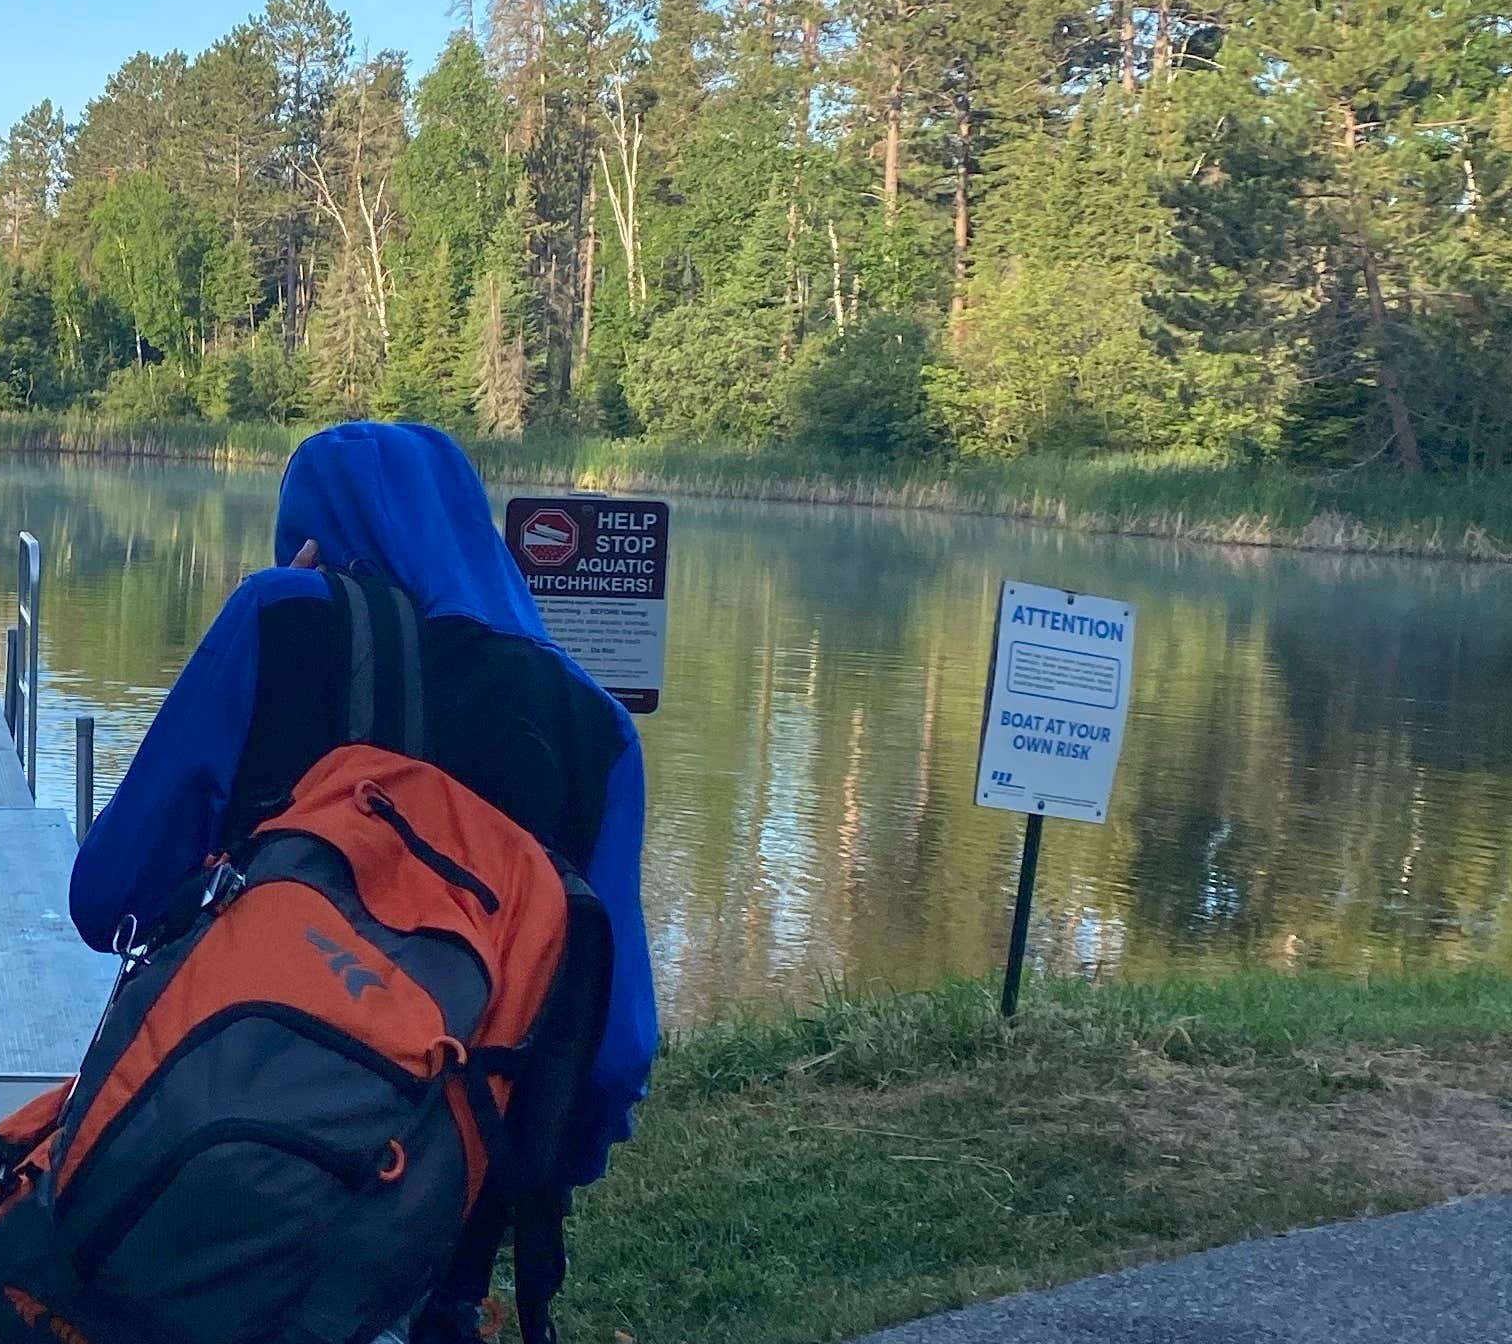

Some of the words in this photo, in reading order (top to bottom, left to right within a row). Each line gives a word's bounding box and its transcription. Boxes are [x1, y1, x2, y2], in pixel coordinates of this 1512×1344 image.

[598, 512, 657, 531] HELP
[595, 535, 656, 554] STOP
[576, 559, 655, 574] AQUATIC
[527, 575, 654, 593] HITCHHIKERS!
[1011, 605, 1124, 642] ATTENTION
[1000, 710, 1044, 731] BOAT
[1045, 717, 1065, 736] AT
[1068, 720, 1111, 743] YOUR
[1013, 735, 1054, 755] OWN
[1056, 740, 1092, 761] RISK
